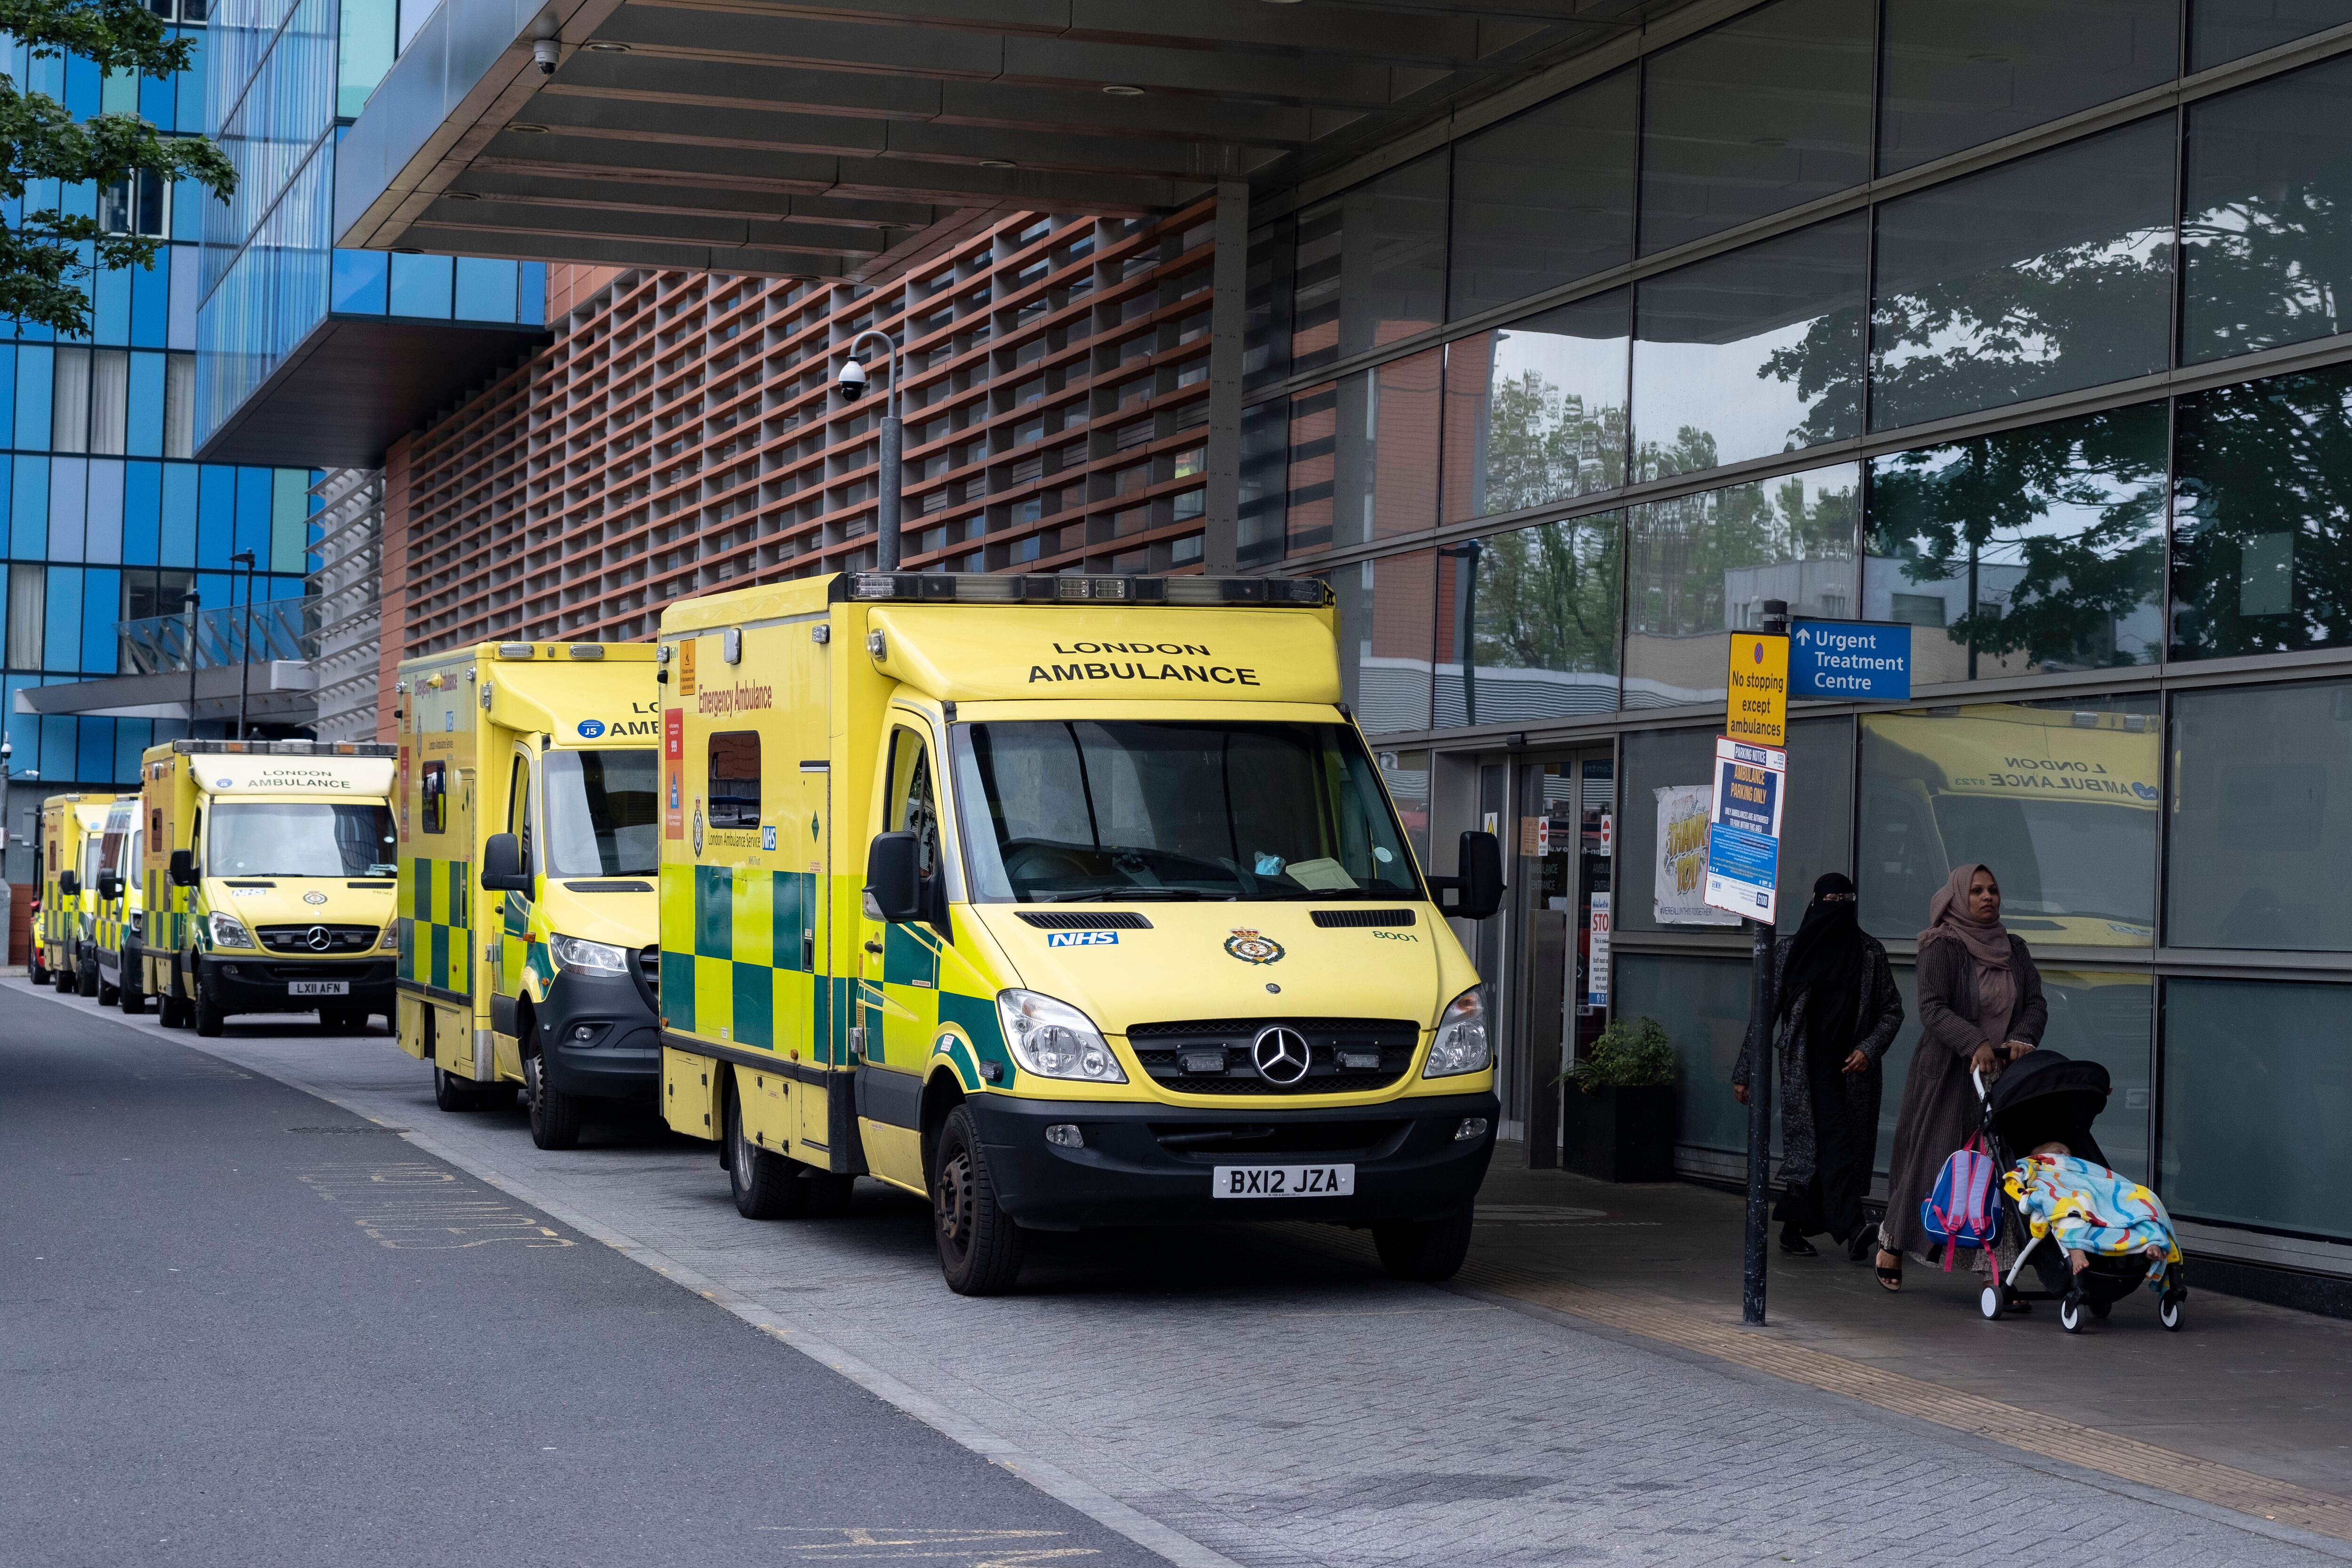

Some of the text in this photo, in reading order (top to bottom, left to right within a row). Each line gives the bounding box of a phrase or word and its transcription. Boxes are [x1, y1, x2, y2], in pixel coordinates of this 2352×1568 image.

[1053, 643, 1211, 656] LONDON
[1816, 631, 1876, 651] Urgent
[1815, 652, 1904, 671] Treatment
[1028, 663, 1261, 686] AMBULANCE
[1732, 670, 1783, 693] No stopping
[1815, 672, 1871, 690] Centre
[699, 679, 772, 718] Emergency Ambulance
[1742, 698, 1771, 716] except
[1731, 717, 1780, 736] ambulances
[1735, 746, 1765, 763] PARKING NOTICE
[248, 779, 351, 788] AMBULANCE
[1734, 765, 1765, 785] AMBULANCE
[1731, 783, 1767, 804] PARKING ONLY
[708, 831, 761, 848] London Ambulance Service
[763, 828, 775, 849] NHS
[1669, 810, 1710, 857] THANK
[1530, 864, 1558, 874] AMBULANCE
[1677, 852, 1700, 895] YOU
[1532, 881, 1555, 891] ENTRANCE
[1757, 894, 1767, 906] £100
[1660, 907, 1712, 916] #WEREALLINTHISTOGETHER
[1593, 914, 1609, 931] STO
[1050, 932, 1117, 946] NHS
[1372, 931, 1419, 942] 8001
[297, 983, 340, 993] LX11 AFN
[1230, 1169, 1338, 1193] BX12 JZA
